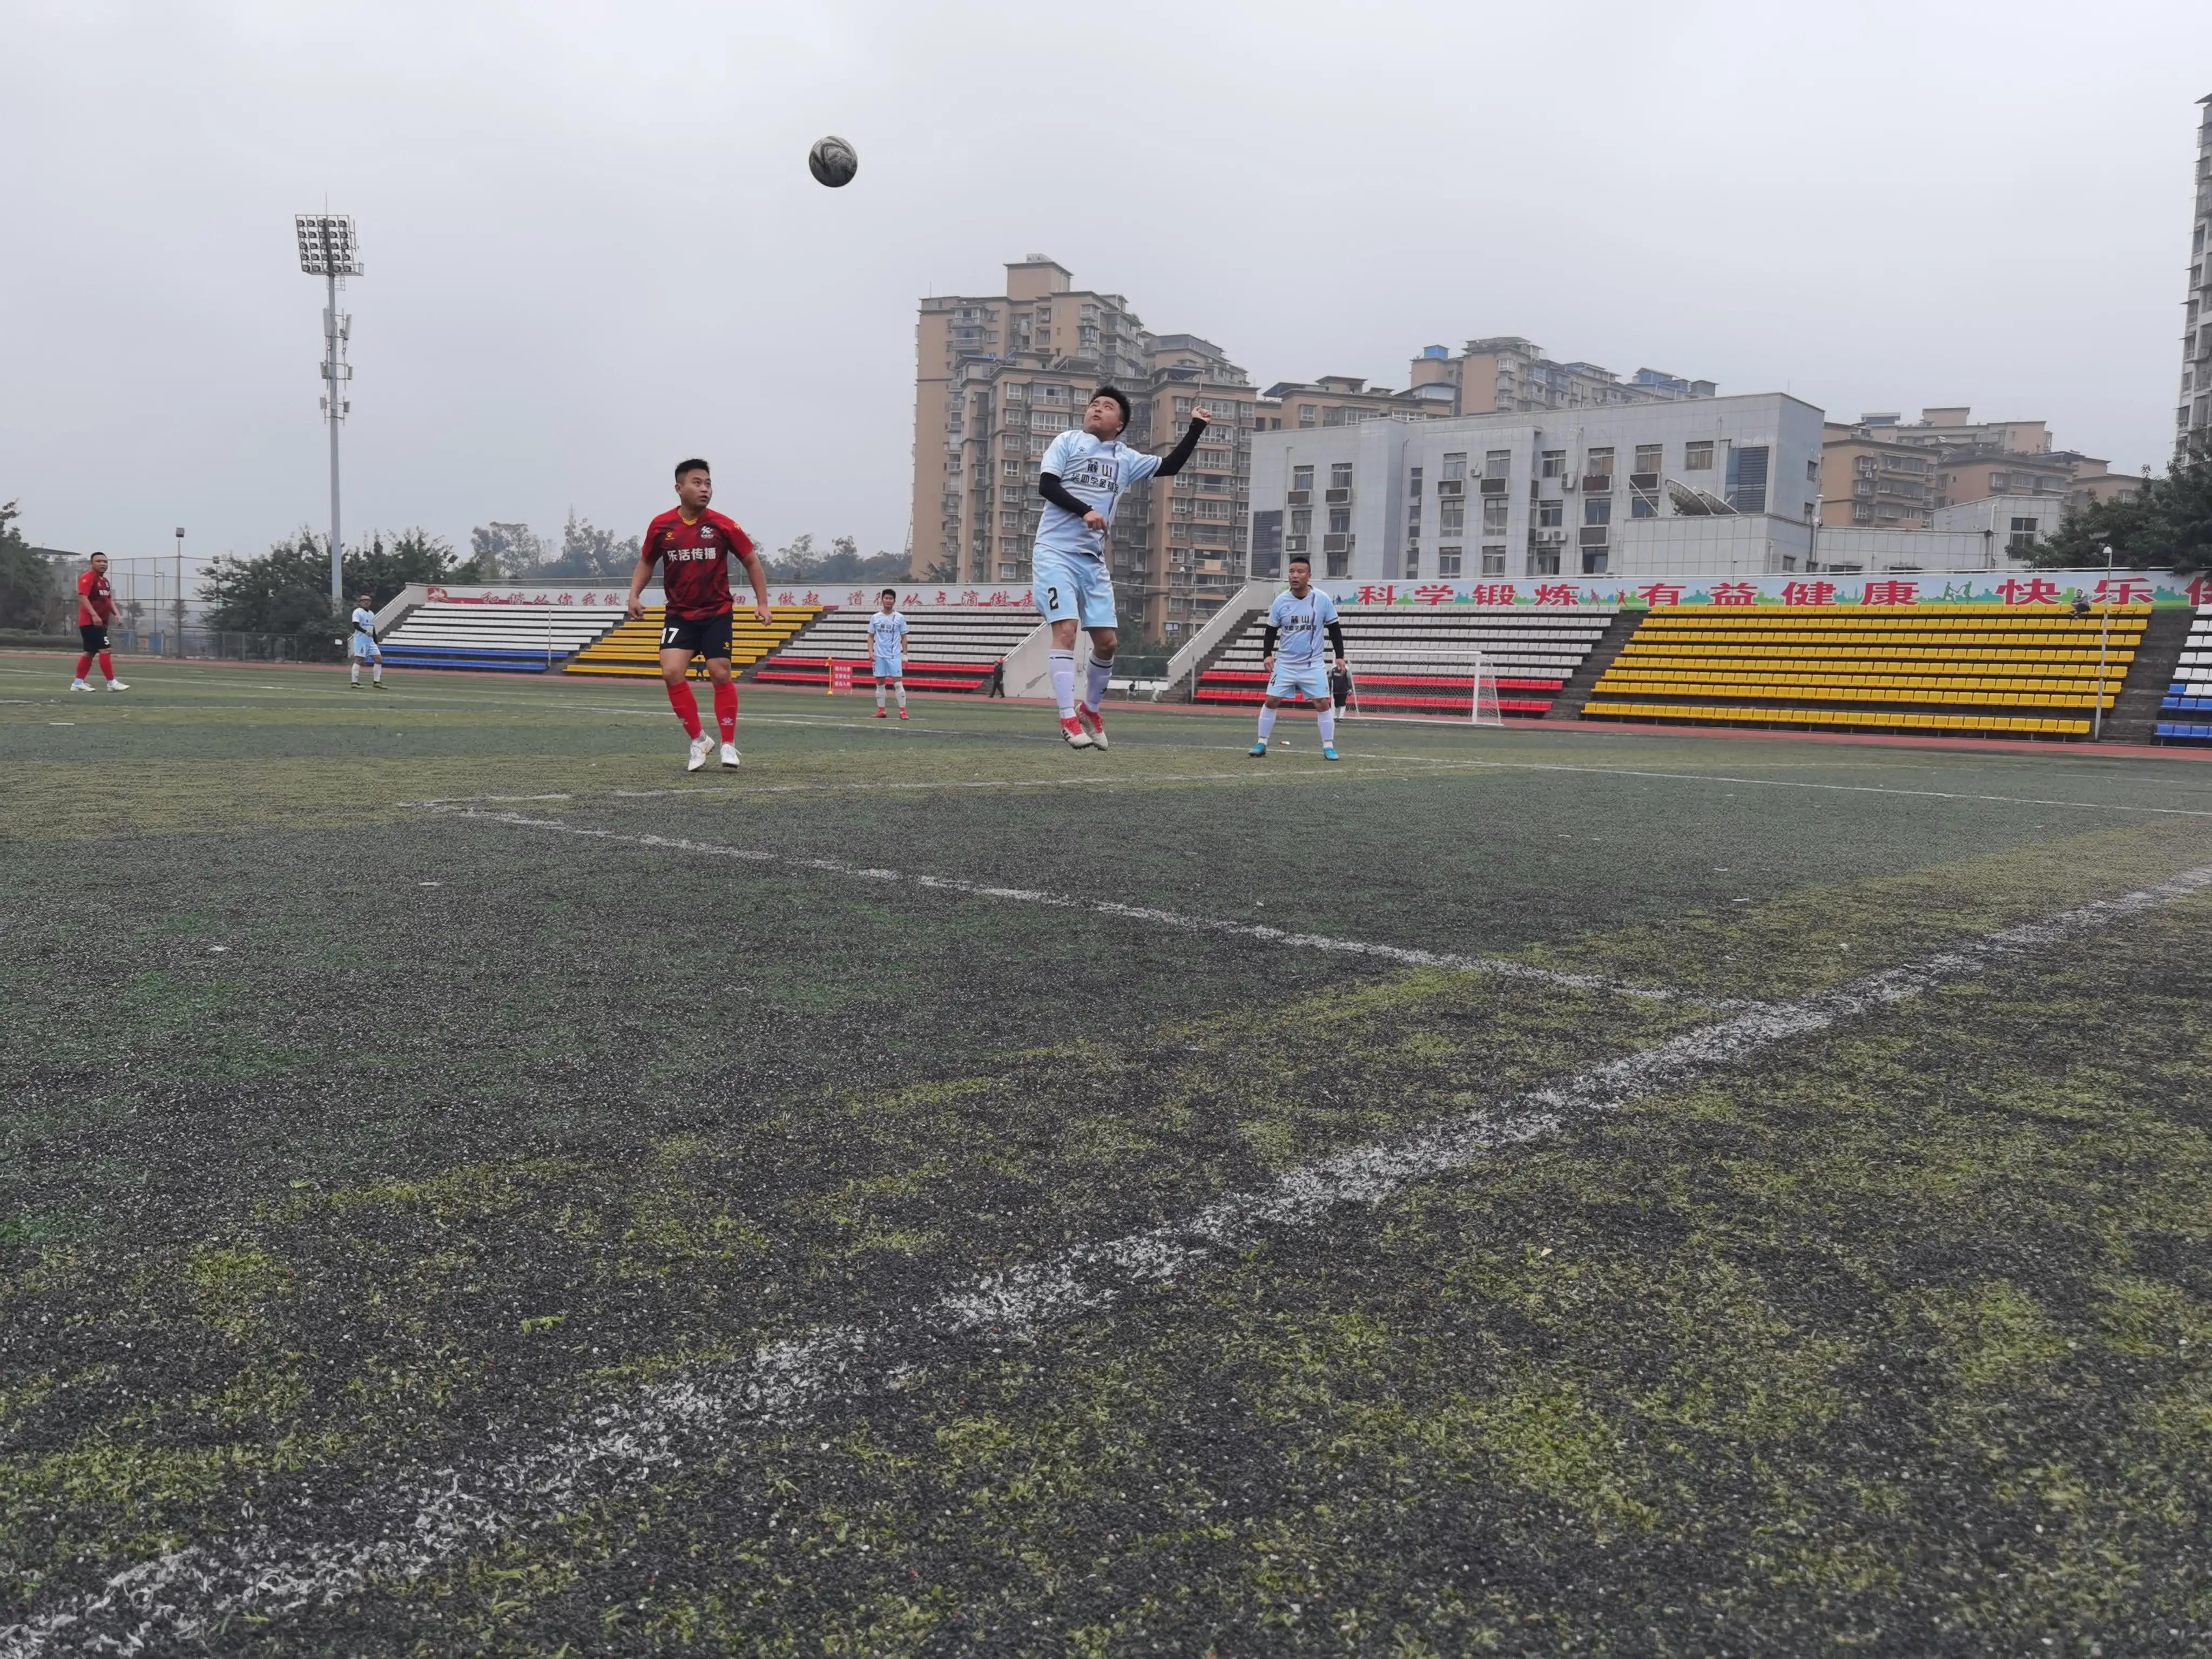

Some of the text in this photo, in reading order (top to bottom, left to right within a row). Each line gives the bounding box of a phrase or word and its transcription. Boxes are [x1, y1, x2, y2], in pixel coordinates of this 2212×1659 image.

[667, 547, 716, 562] 乐活传播
[1048, 587, 1058, 610] 2
[1358, 584, 1580, 605] 科学锻炼
[1638, 580, 1920, 605] 有益健康
[661, 627, 679, 644] 17
